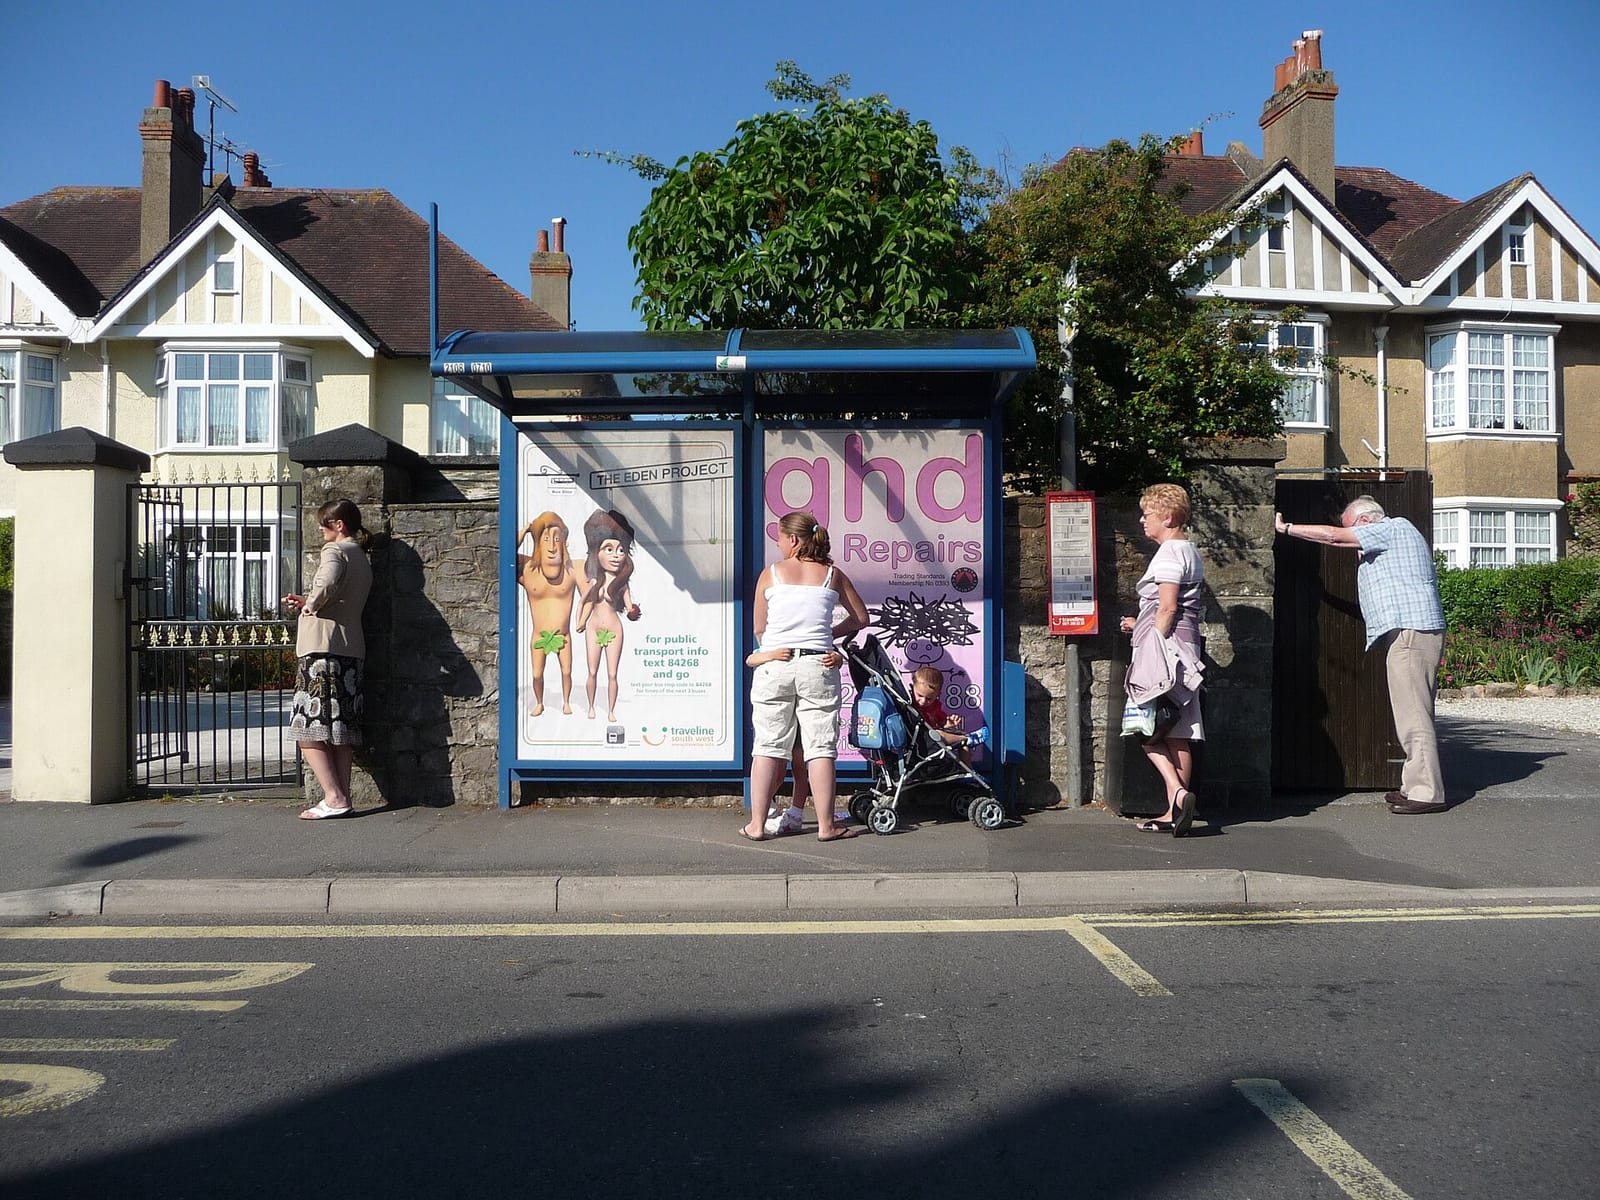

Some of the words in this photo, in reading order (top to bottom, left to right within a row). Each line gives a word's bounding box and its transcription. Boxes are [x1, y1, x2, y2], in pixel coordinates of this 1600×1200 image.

[597, 474, 621, 486] THE
[624, 469, 658, 483] EDEN
[662, 462, 728, 479] PROJECT
[764, 433, 983, 542] ghd
[843, 533, 983, 570] Repairs
[893, 573, 915, 581] Trading
[888, 580, 923, 588] Membership
[645, 634, 661, 643] for
[664, 634, 697, 645] public
[634, 647, 684, 657] transport
[687, 647, 709, 656] info
[643, 659, 665, 667] text
[667, 658, 699, 667] 84268
[652, 670, 673, 678] and
[676, 671, 690, 680] go
[671, 725, 715, 735] traveline
